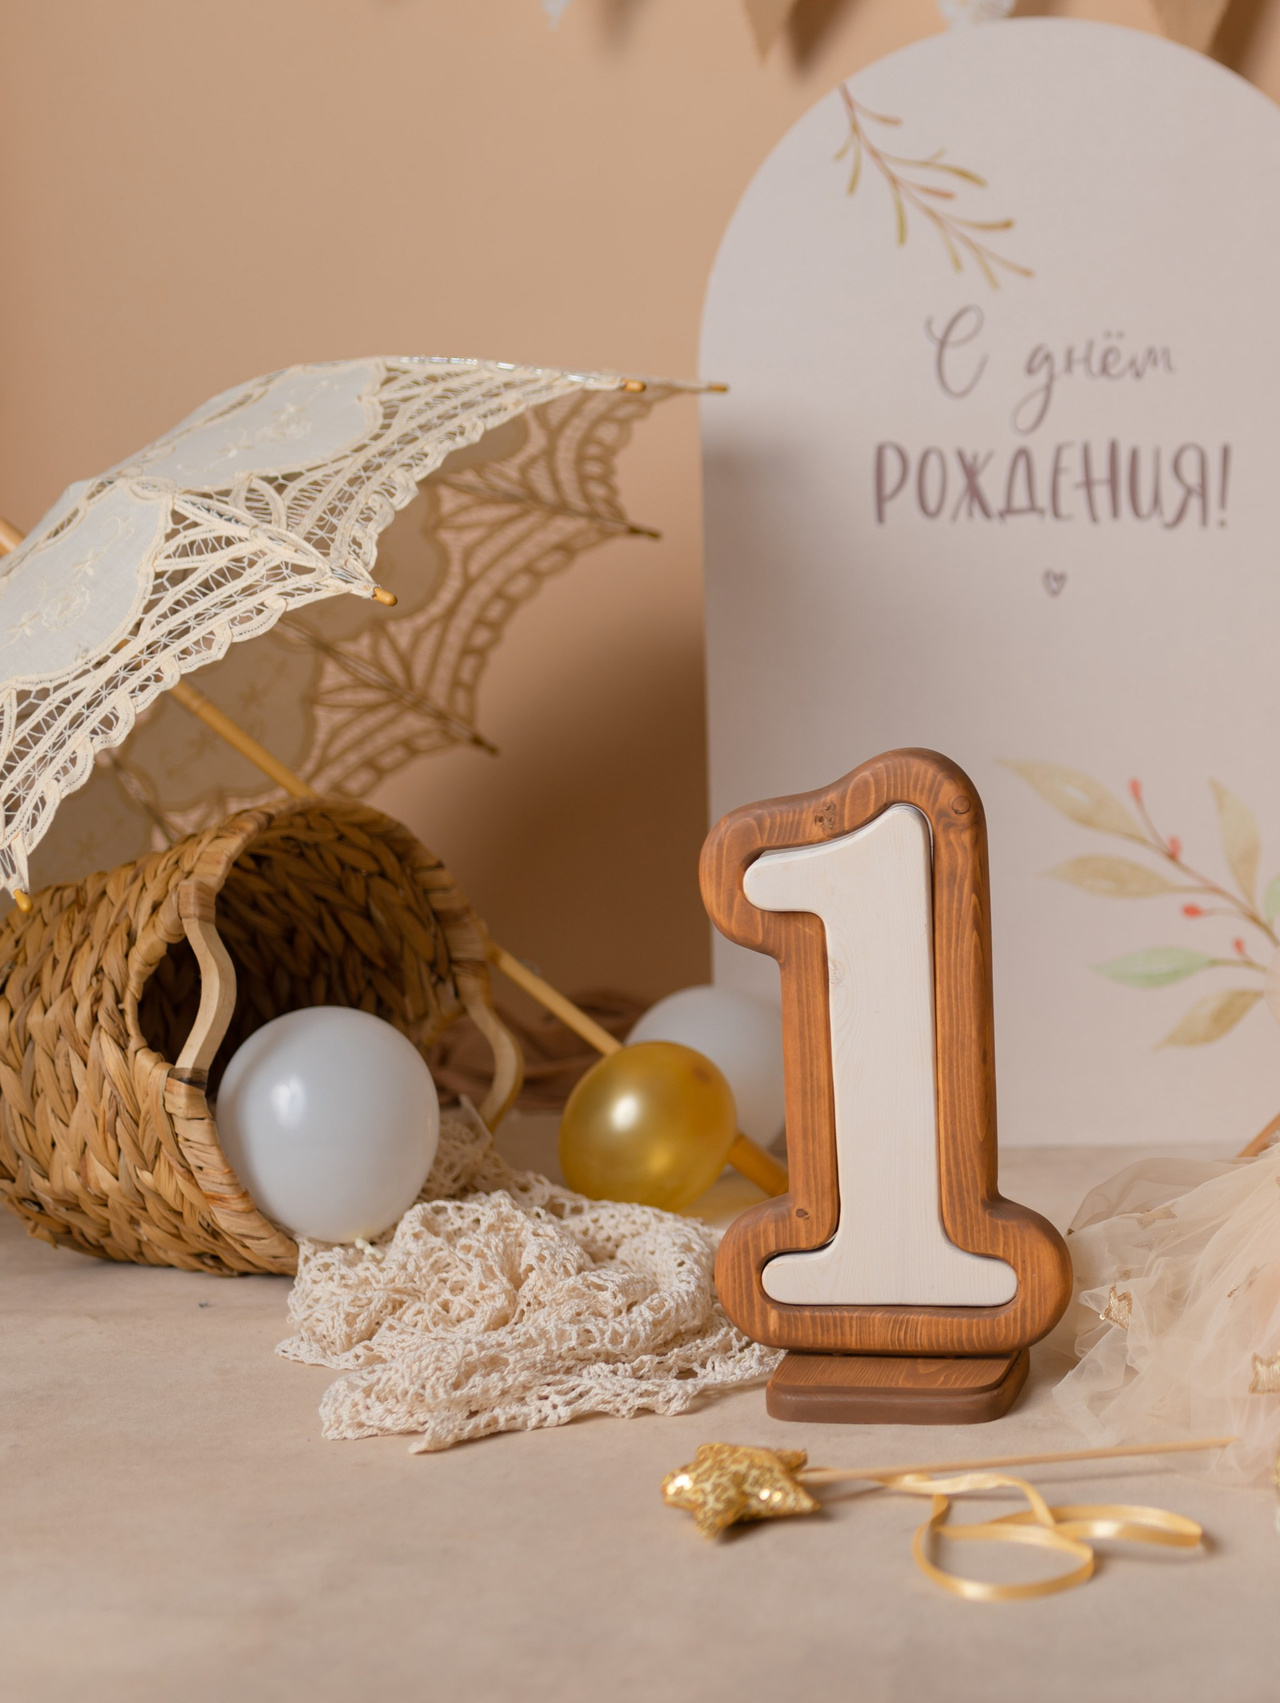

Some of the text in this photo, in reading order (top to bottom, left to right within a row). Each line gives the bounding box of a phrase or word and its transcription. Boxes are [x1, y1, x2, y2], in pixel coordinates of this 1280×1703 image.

[926, 305, 1176, 435] С днём
[874, 440, 1232, 530] РОЖДЕНИЯ!
[742, 803, 1018, 1305] 1
